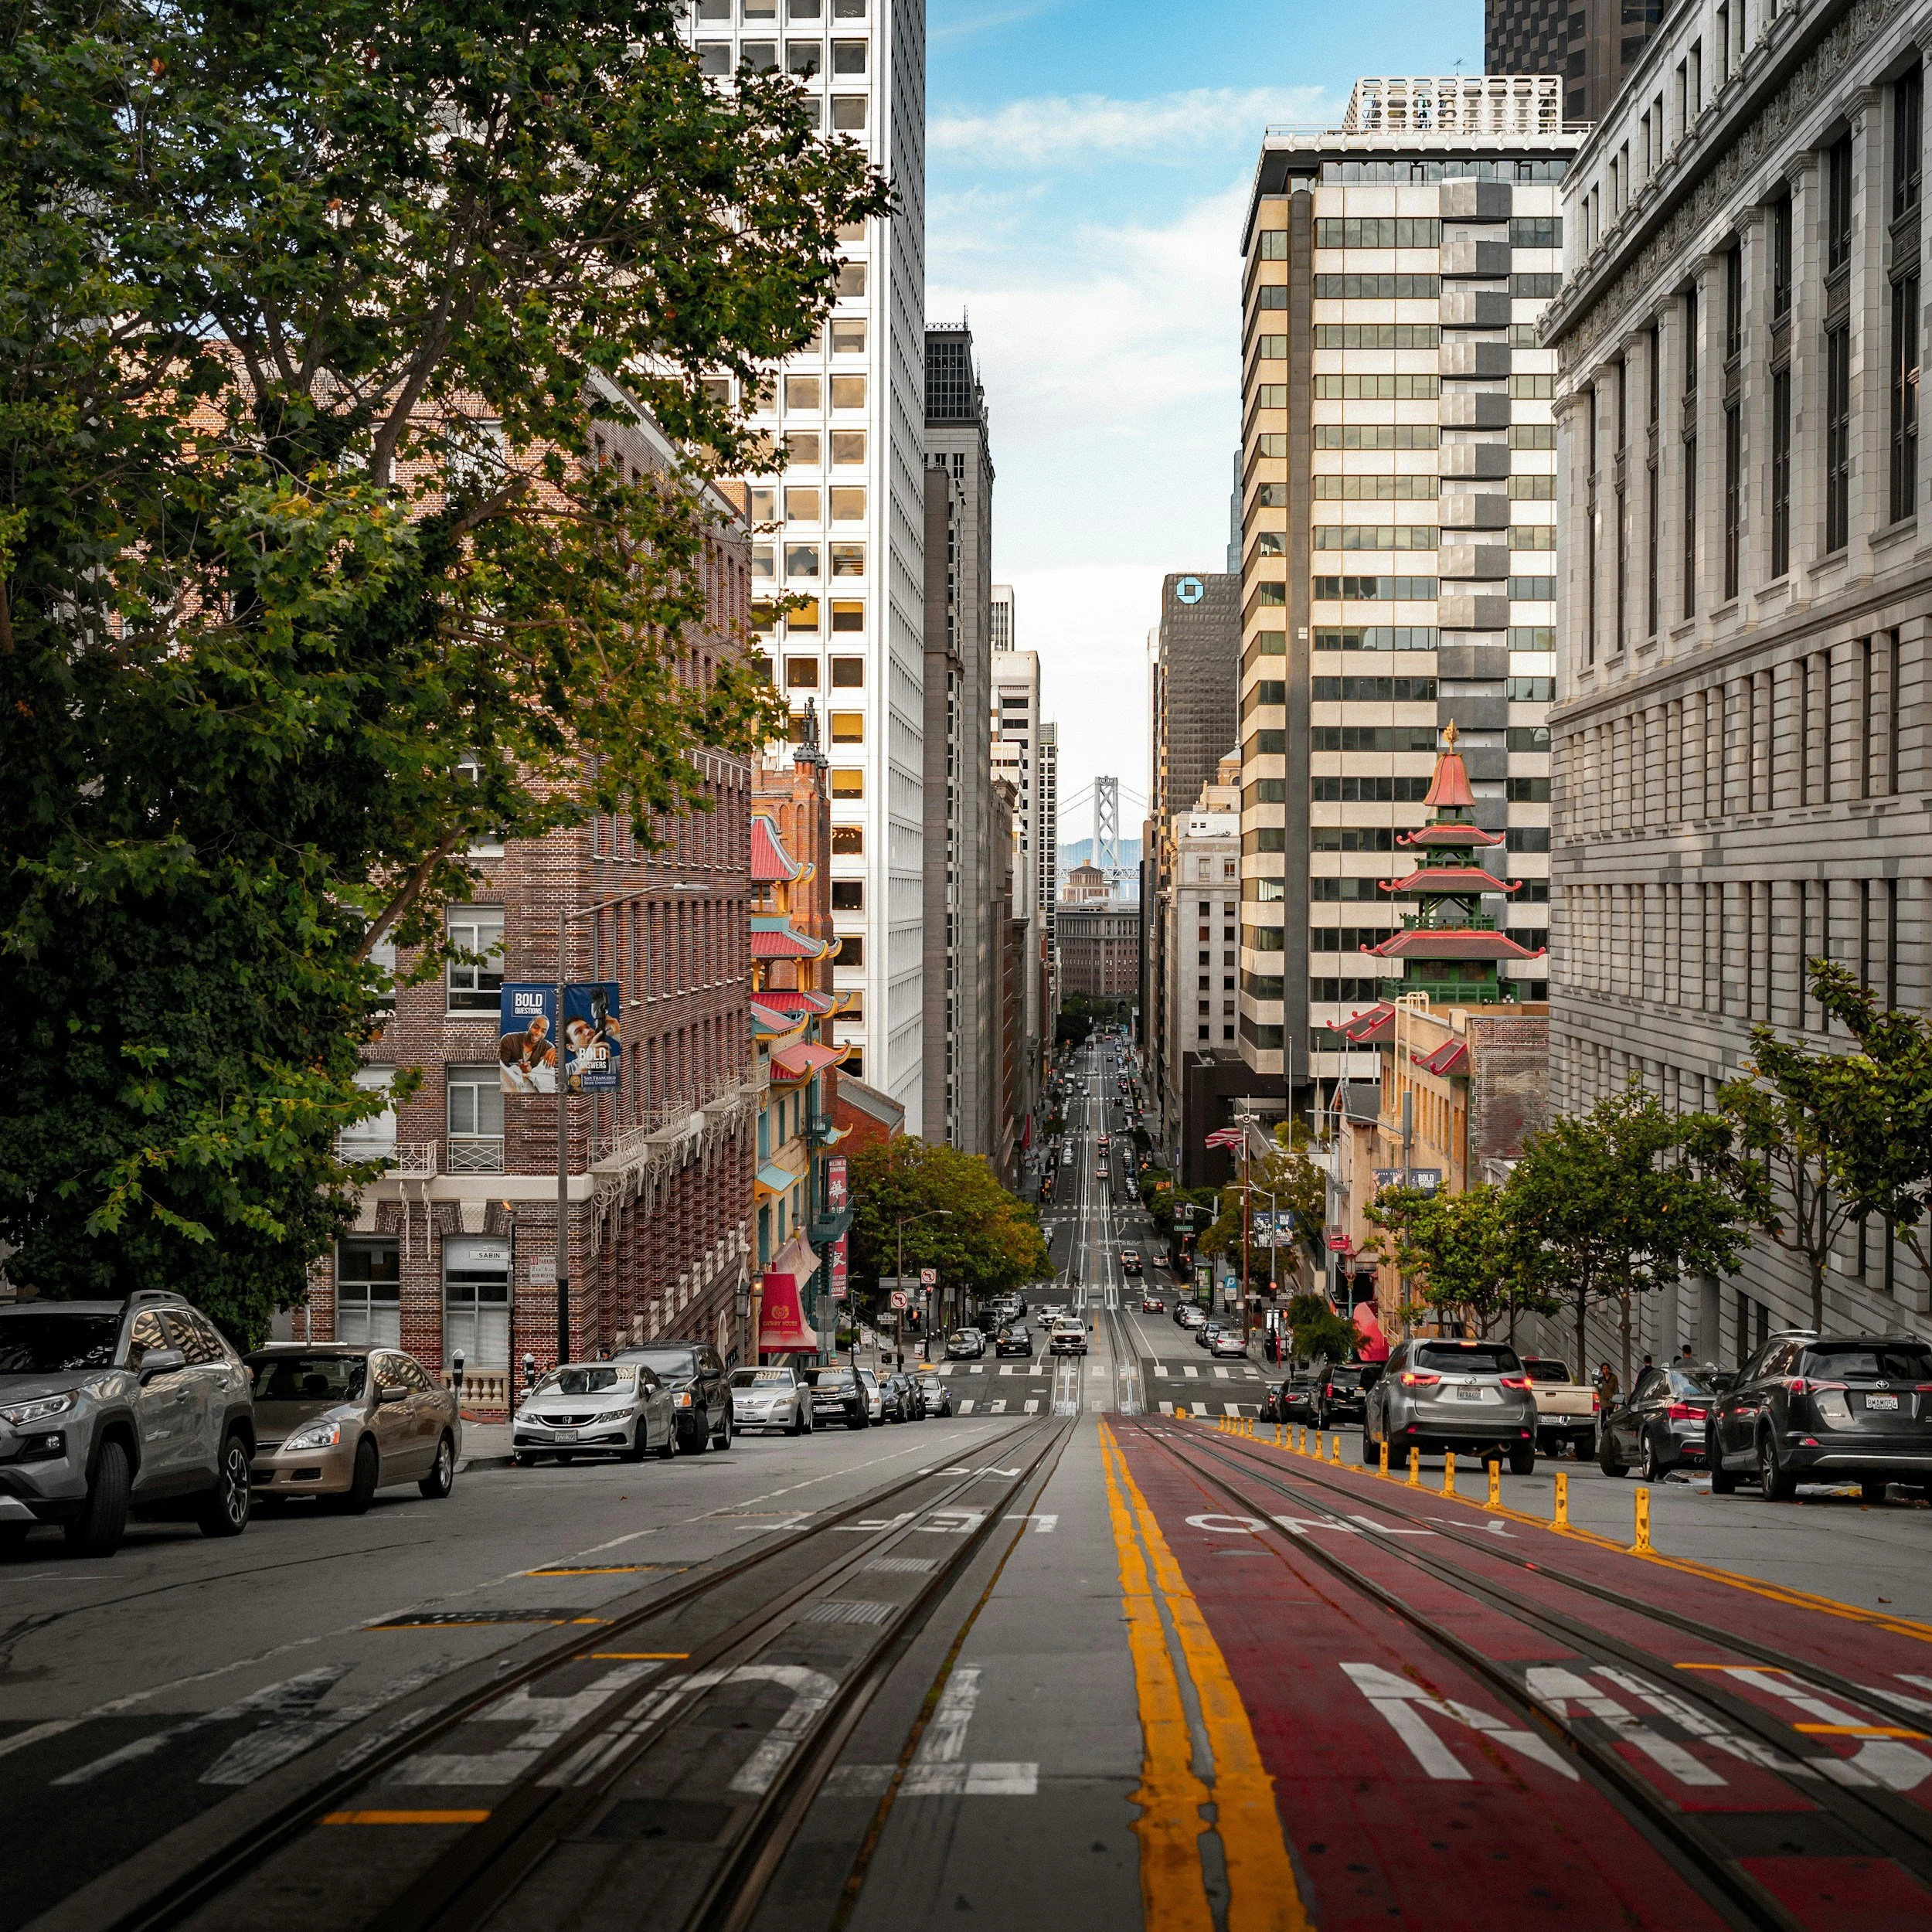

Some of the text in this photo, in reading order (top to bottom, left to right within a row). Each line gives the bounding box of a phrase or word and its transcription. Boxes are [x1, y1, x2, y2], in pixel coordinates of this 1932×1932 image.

[515, 992, 543, 1007] BOLD
[579, 1047, 607, 1061] BOLD
[530, 1256, 538, 1264] NO
[1867, 1399, 1897, 1407] 8MAM054
[917, 1467, 1022, 1477] NO
[734, 1509, 1060, 1533] LEFT
[1185, 1513, 1519, 1538] ONLY
